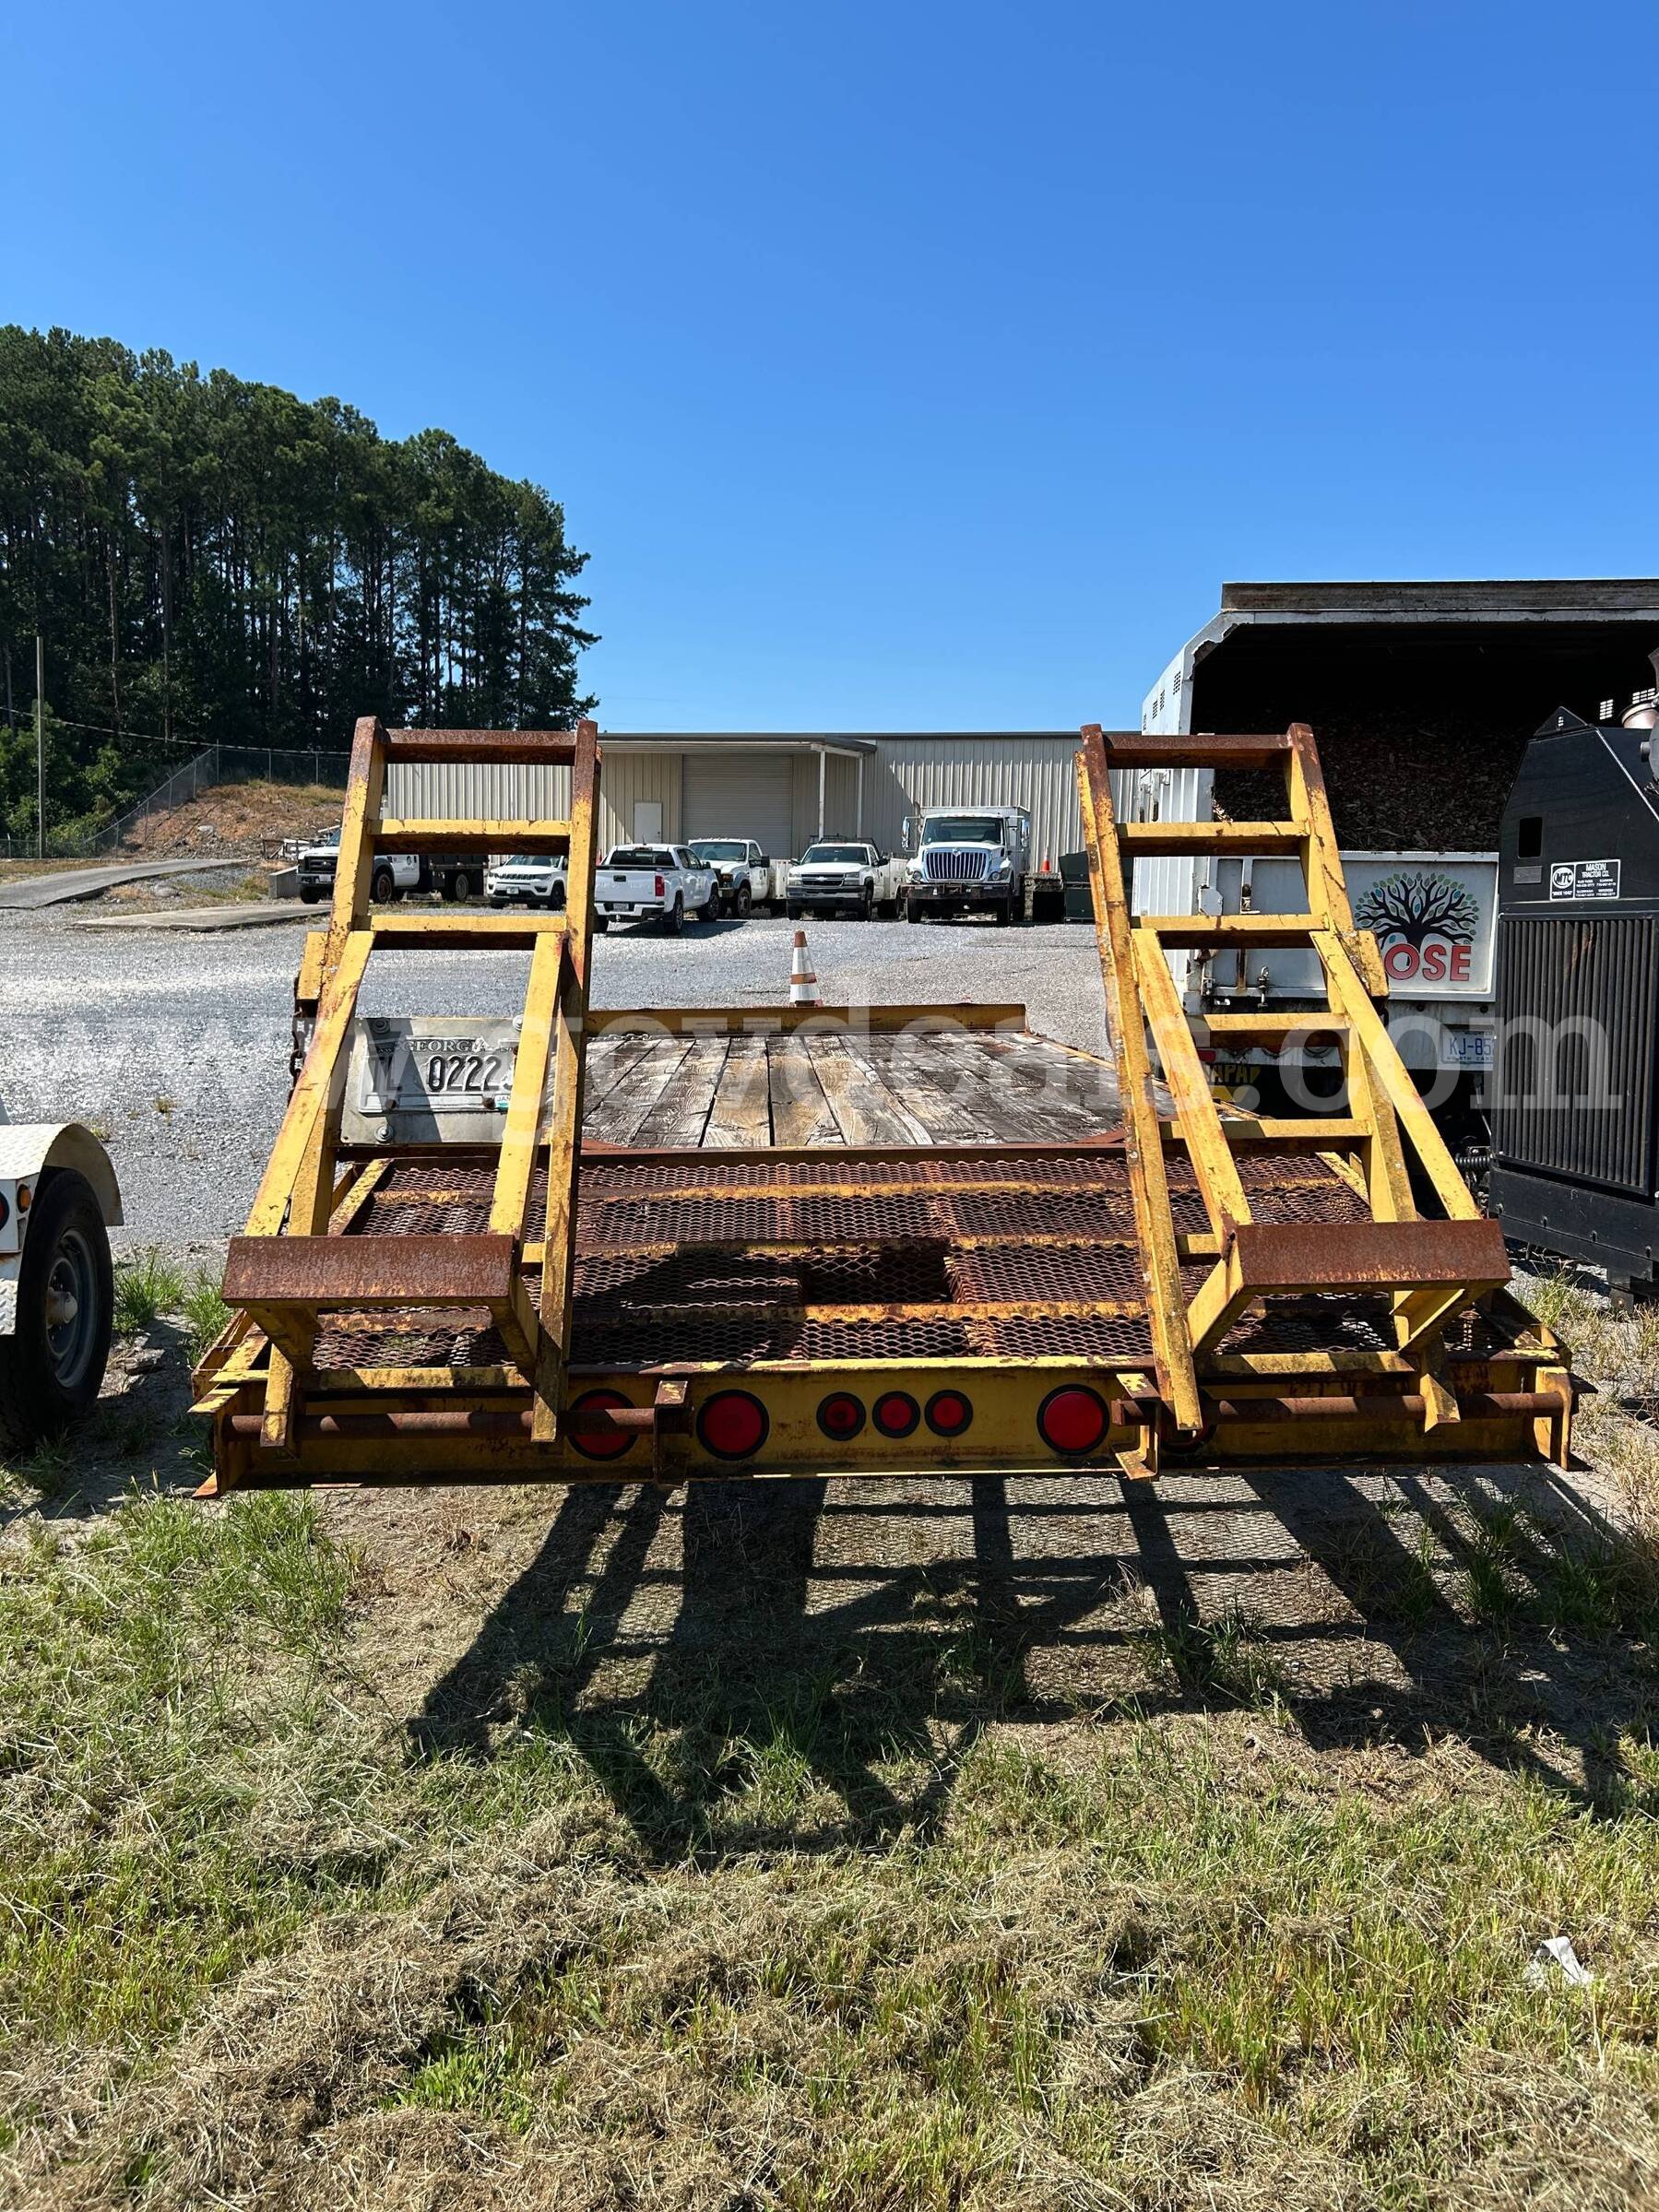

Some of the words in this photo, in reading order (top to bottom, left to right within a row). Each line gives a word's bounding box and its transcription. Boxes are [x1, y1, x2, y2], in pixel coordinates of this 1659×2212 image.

[1585, 863, 1606, 871] MASON
[1555, 872, 1572, 884] MTC
[404, 1038, 488, 1054] GEORGIA
[1449, 1037, 1494, 1056] KJ-85
[428, 1054, 513, 1093] 0222
